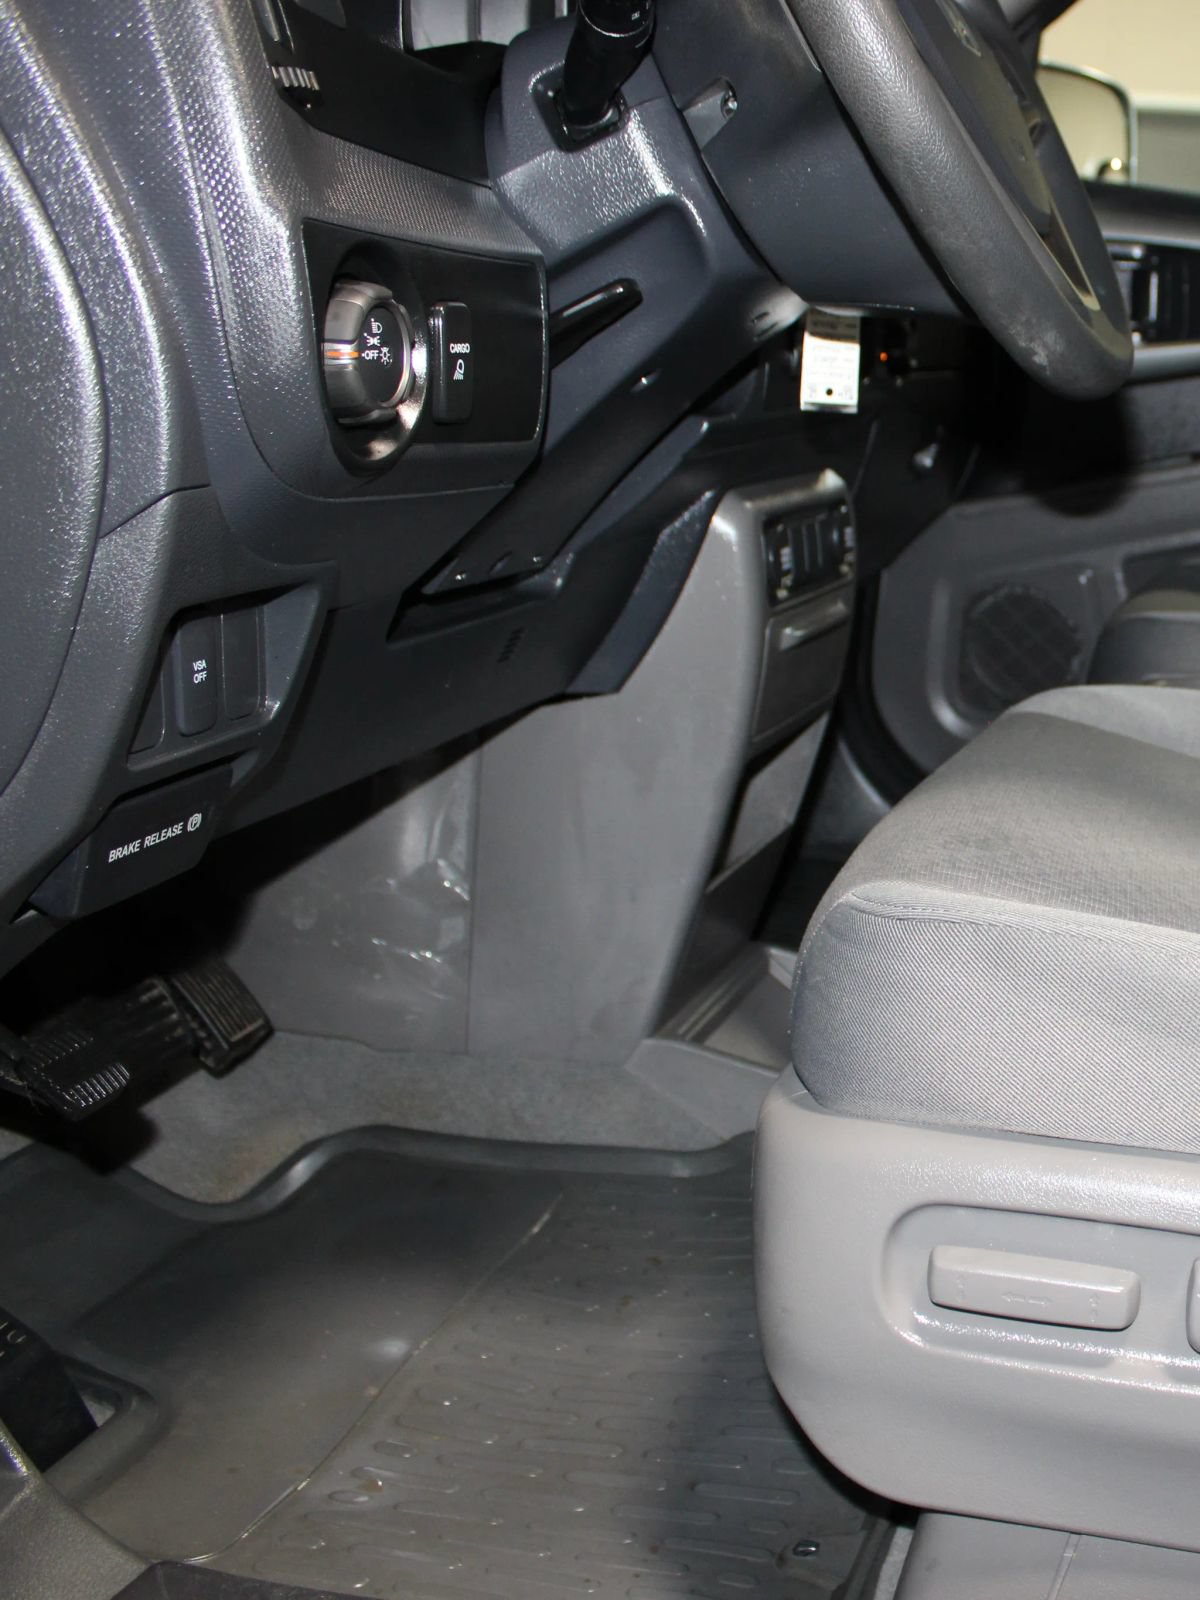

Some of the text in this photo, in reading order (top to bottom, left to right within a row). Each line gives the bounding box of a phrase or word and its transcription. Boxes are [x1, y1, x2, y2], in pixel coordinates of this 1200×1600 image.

[449, 343, 471, 354] CARGO
[364, 350, 379, 360] OFF
[192, 659, 207, 671] VSA
[193, 670, 208, 684] OFF
[108, 821, 184, 863] BRAKE RELEASE
